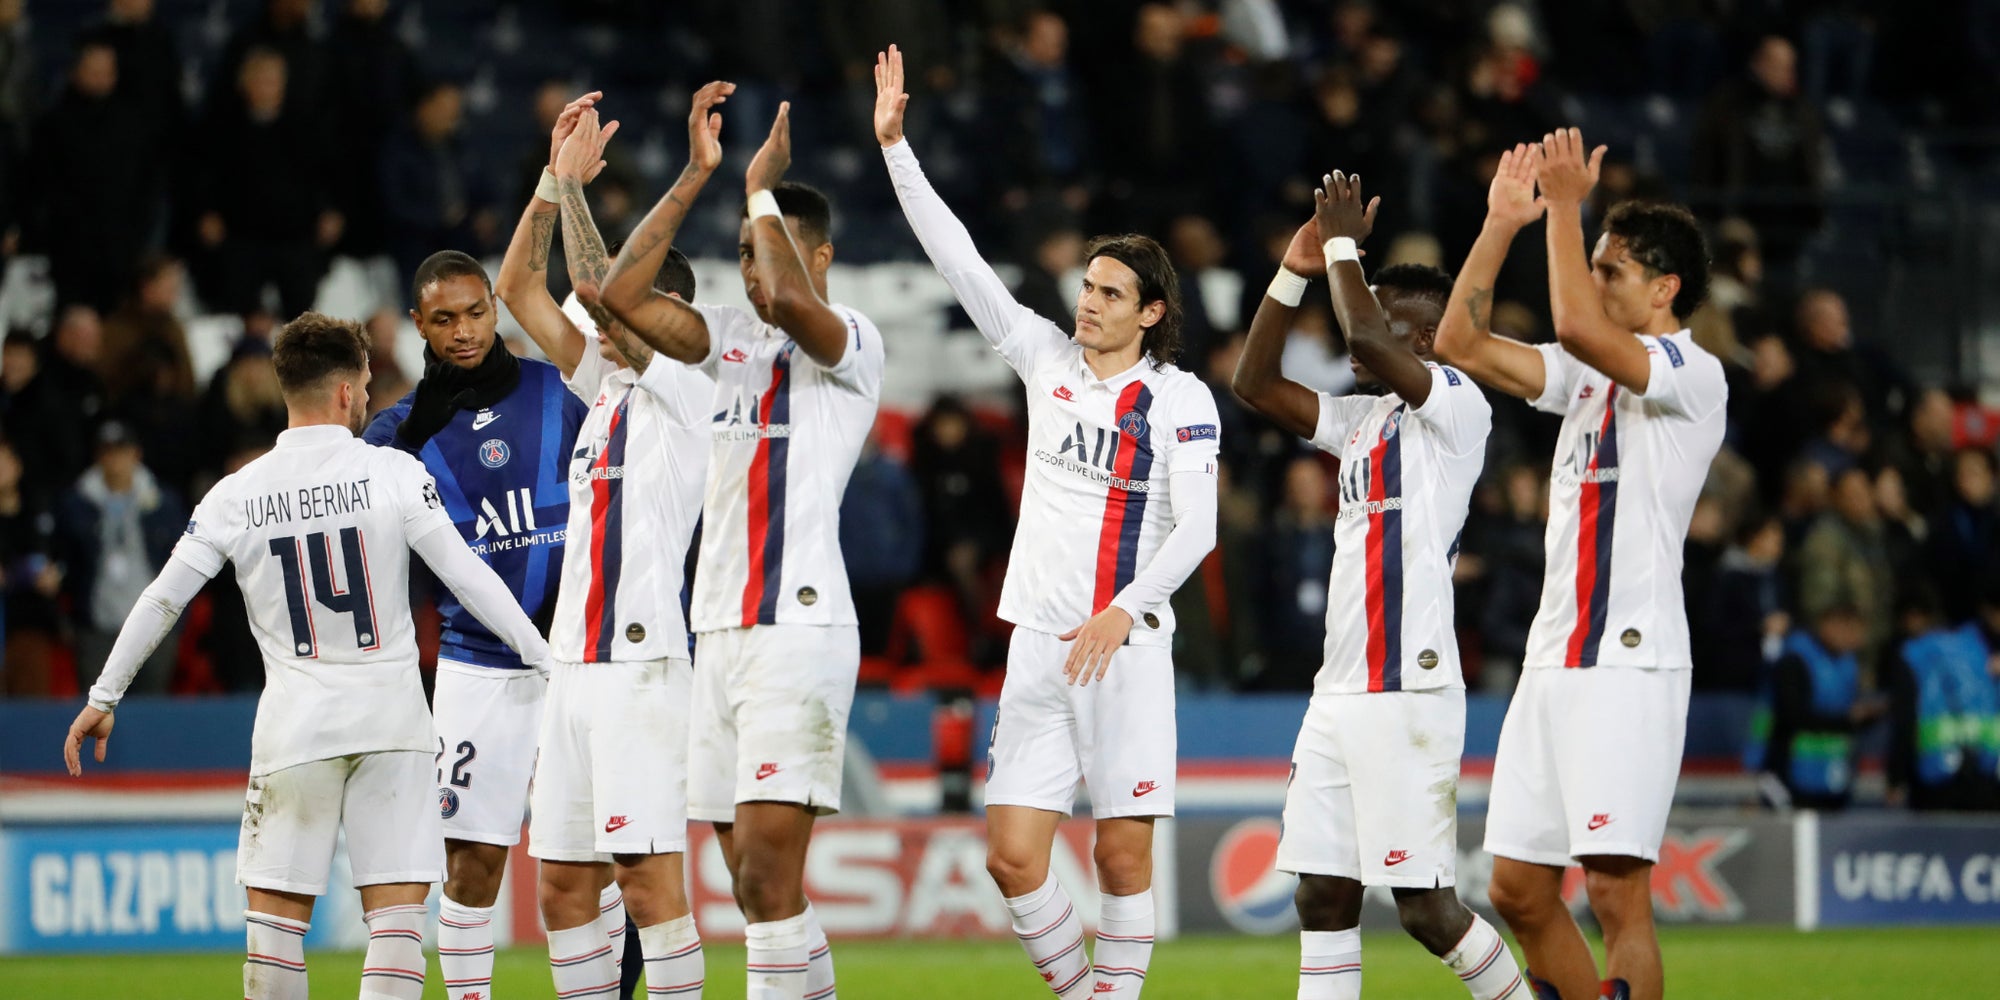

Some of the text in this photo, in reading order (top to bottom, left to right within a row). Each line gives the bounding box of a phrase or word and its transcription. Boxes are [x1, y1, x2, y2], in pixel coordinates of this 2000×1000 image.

[1058, 385, 1074, 398] NIKE
[476, 411, 494, 423] NIKE
[1034, 449, 1151, 492] ACCOR LIVE LIMITLESS
[245, 478, 371, 530] JUAN BERNAT
[489, 539, 513, 554] LIVE
[514, 530, 568, 548] LIMITLESS
[268, 526, 381, 659] 14
[760, 763, 779, 771] NIKE
[1137, 781, 1156, 790] NIKE
[609, 815, 627, 824] NIKE
[1389, 850, 1408, 859] NIKE
[1833, 851, 1953, 903] UEFA
[31, 852, 249, 935] GAZPRO
[1096, 981, 1115, 990] NIKE
[462, 992, 481, 1000] NIKE
